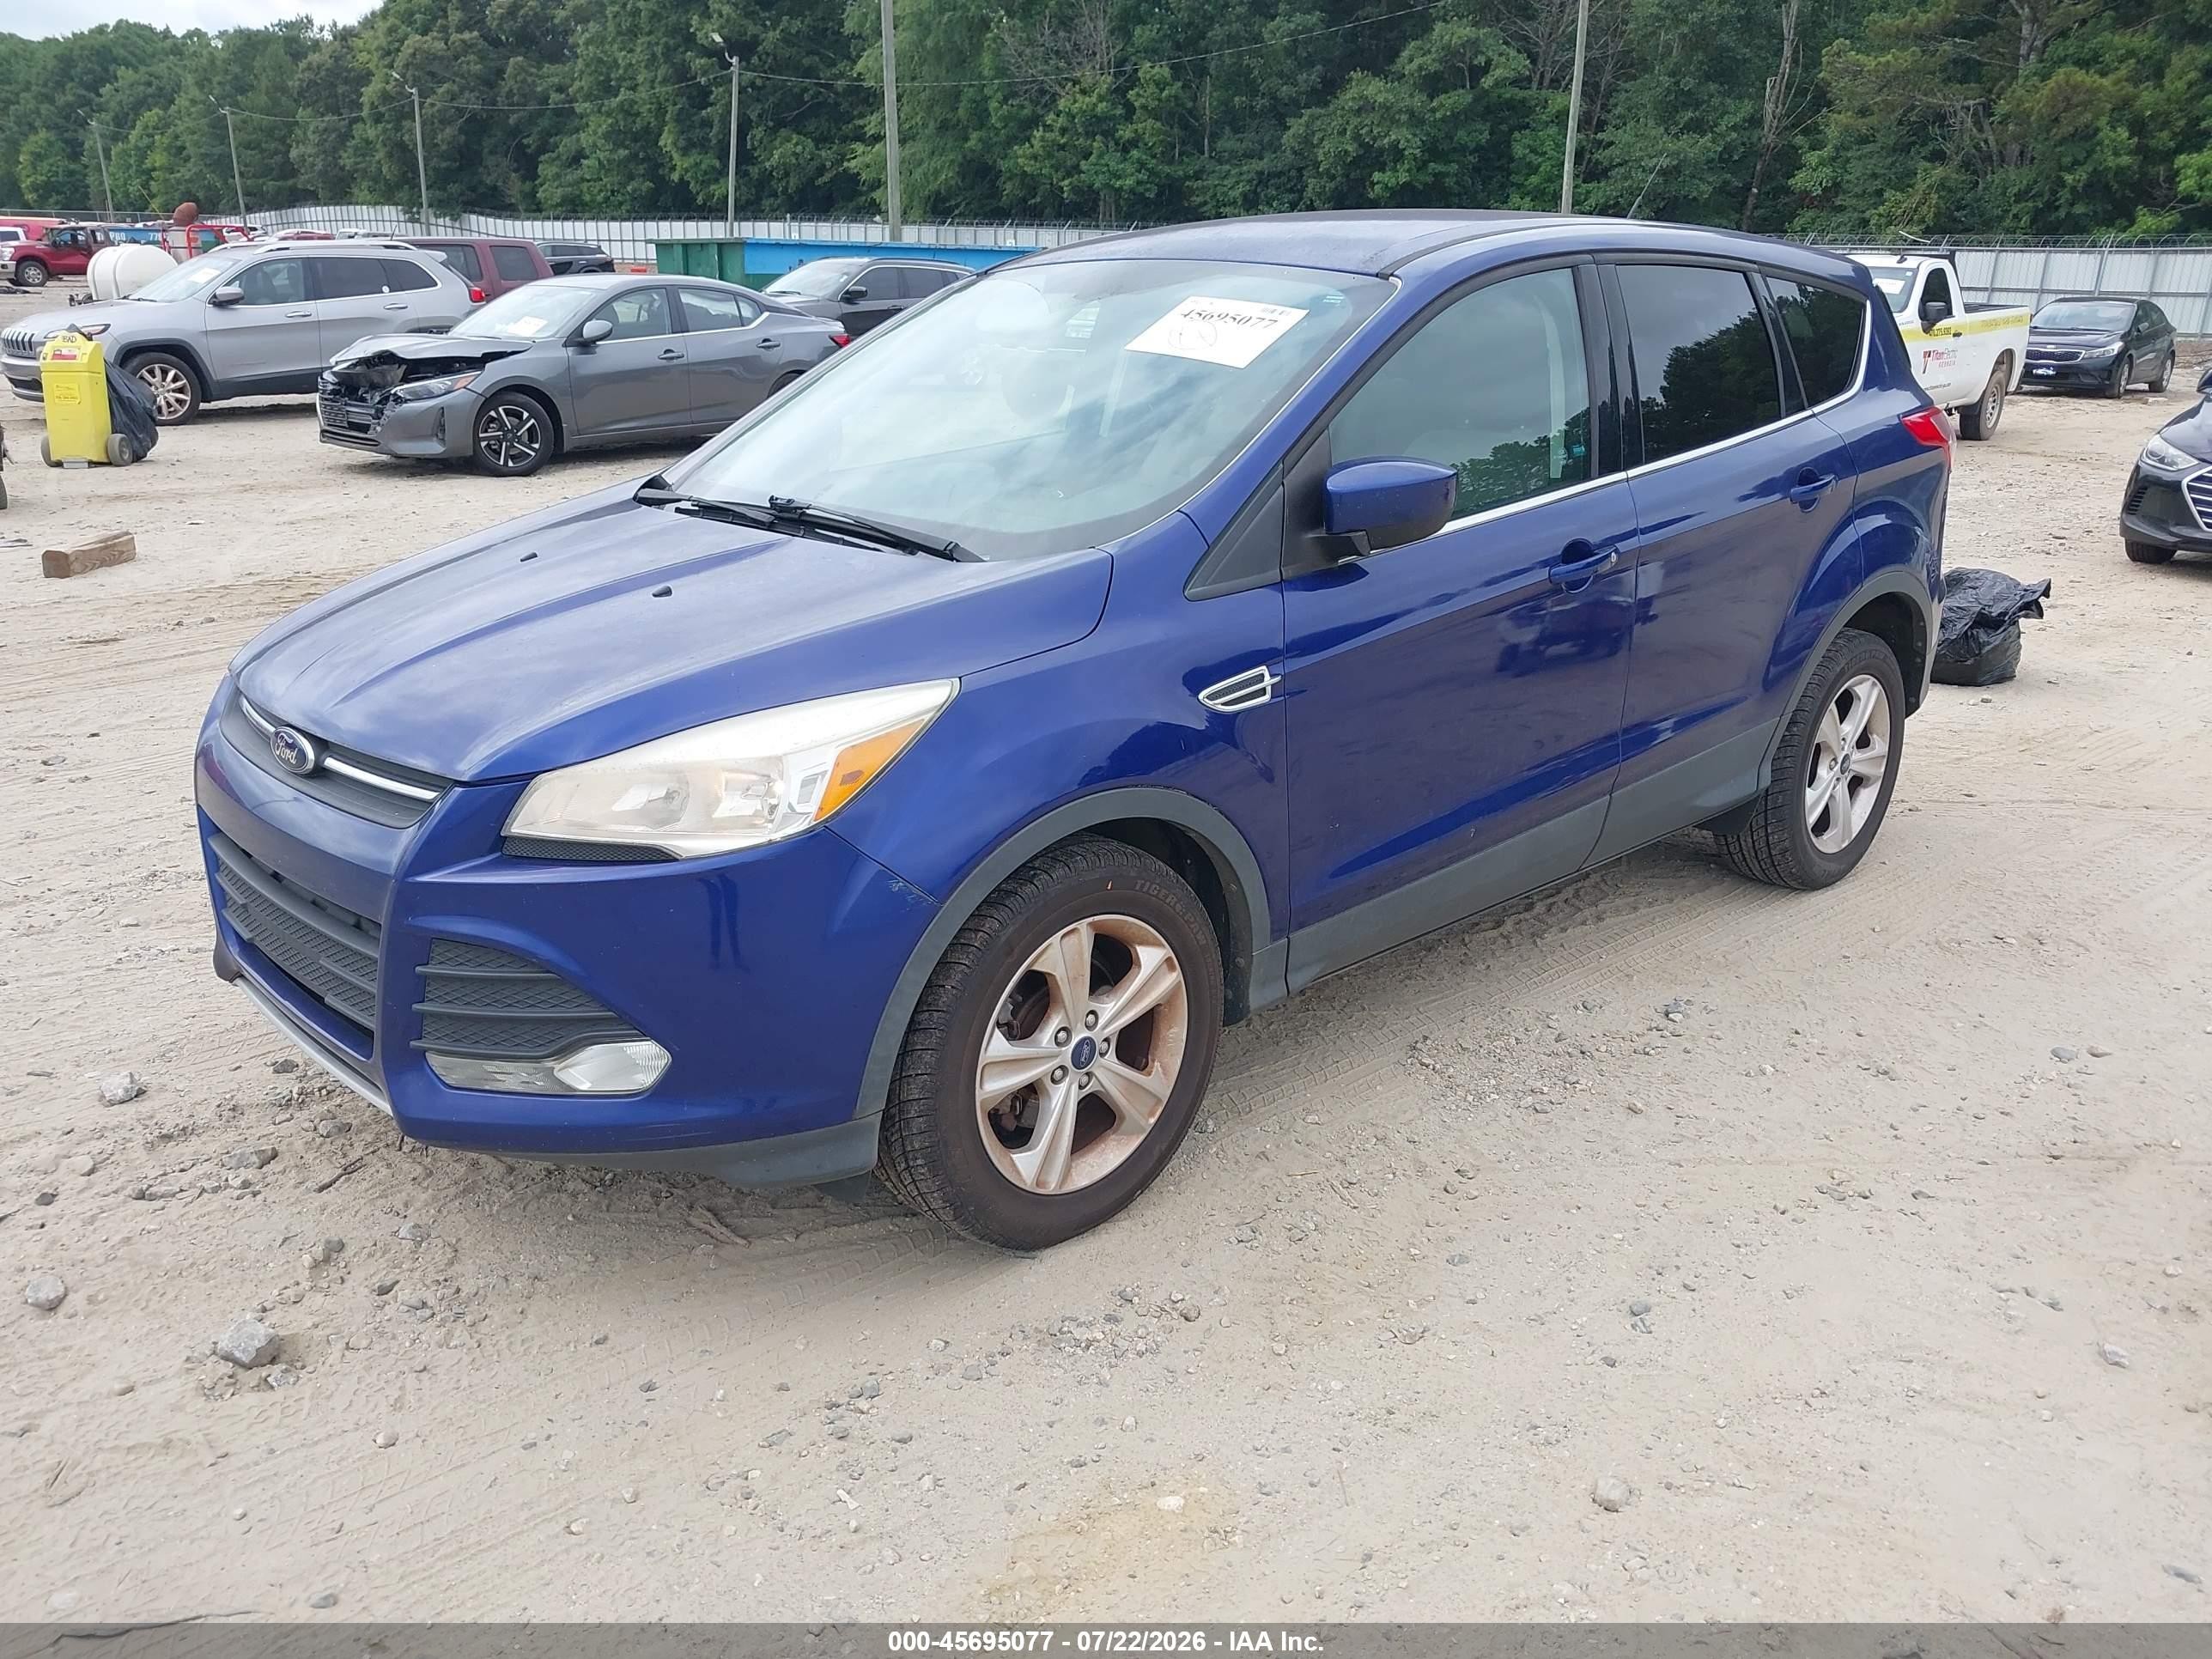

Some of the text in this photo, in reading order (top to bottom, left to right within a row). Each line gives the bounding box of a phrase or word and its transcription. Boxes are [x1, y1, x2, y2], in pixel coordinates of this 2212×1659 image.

[1181, 308, 1279, 329] 45695077
[62, 335, 77, 343] BAD
[275, 732, 298, 764] Ford
[1133, 878, 1177, 908] TIGER
